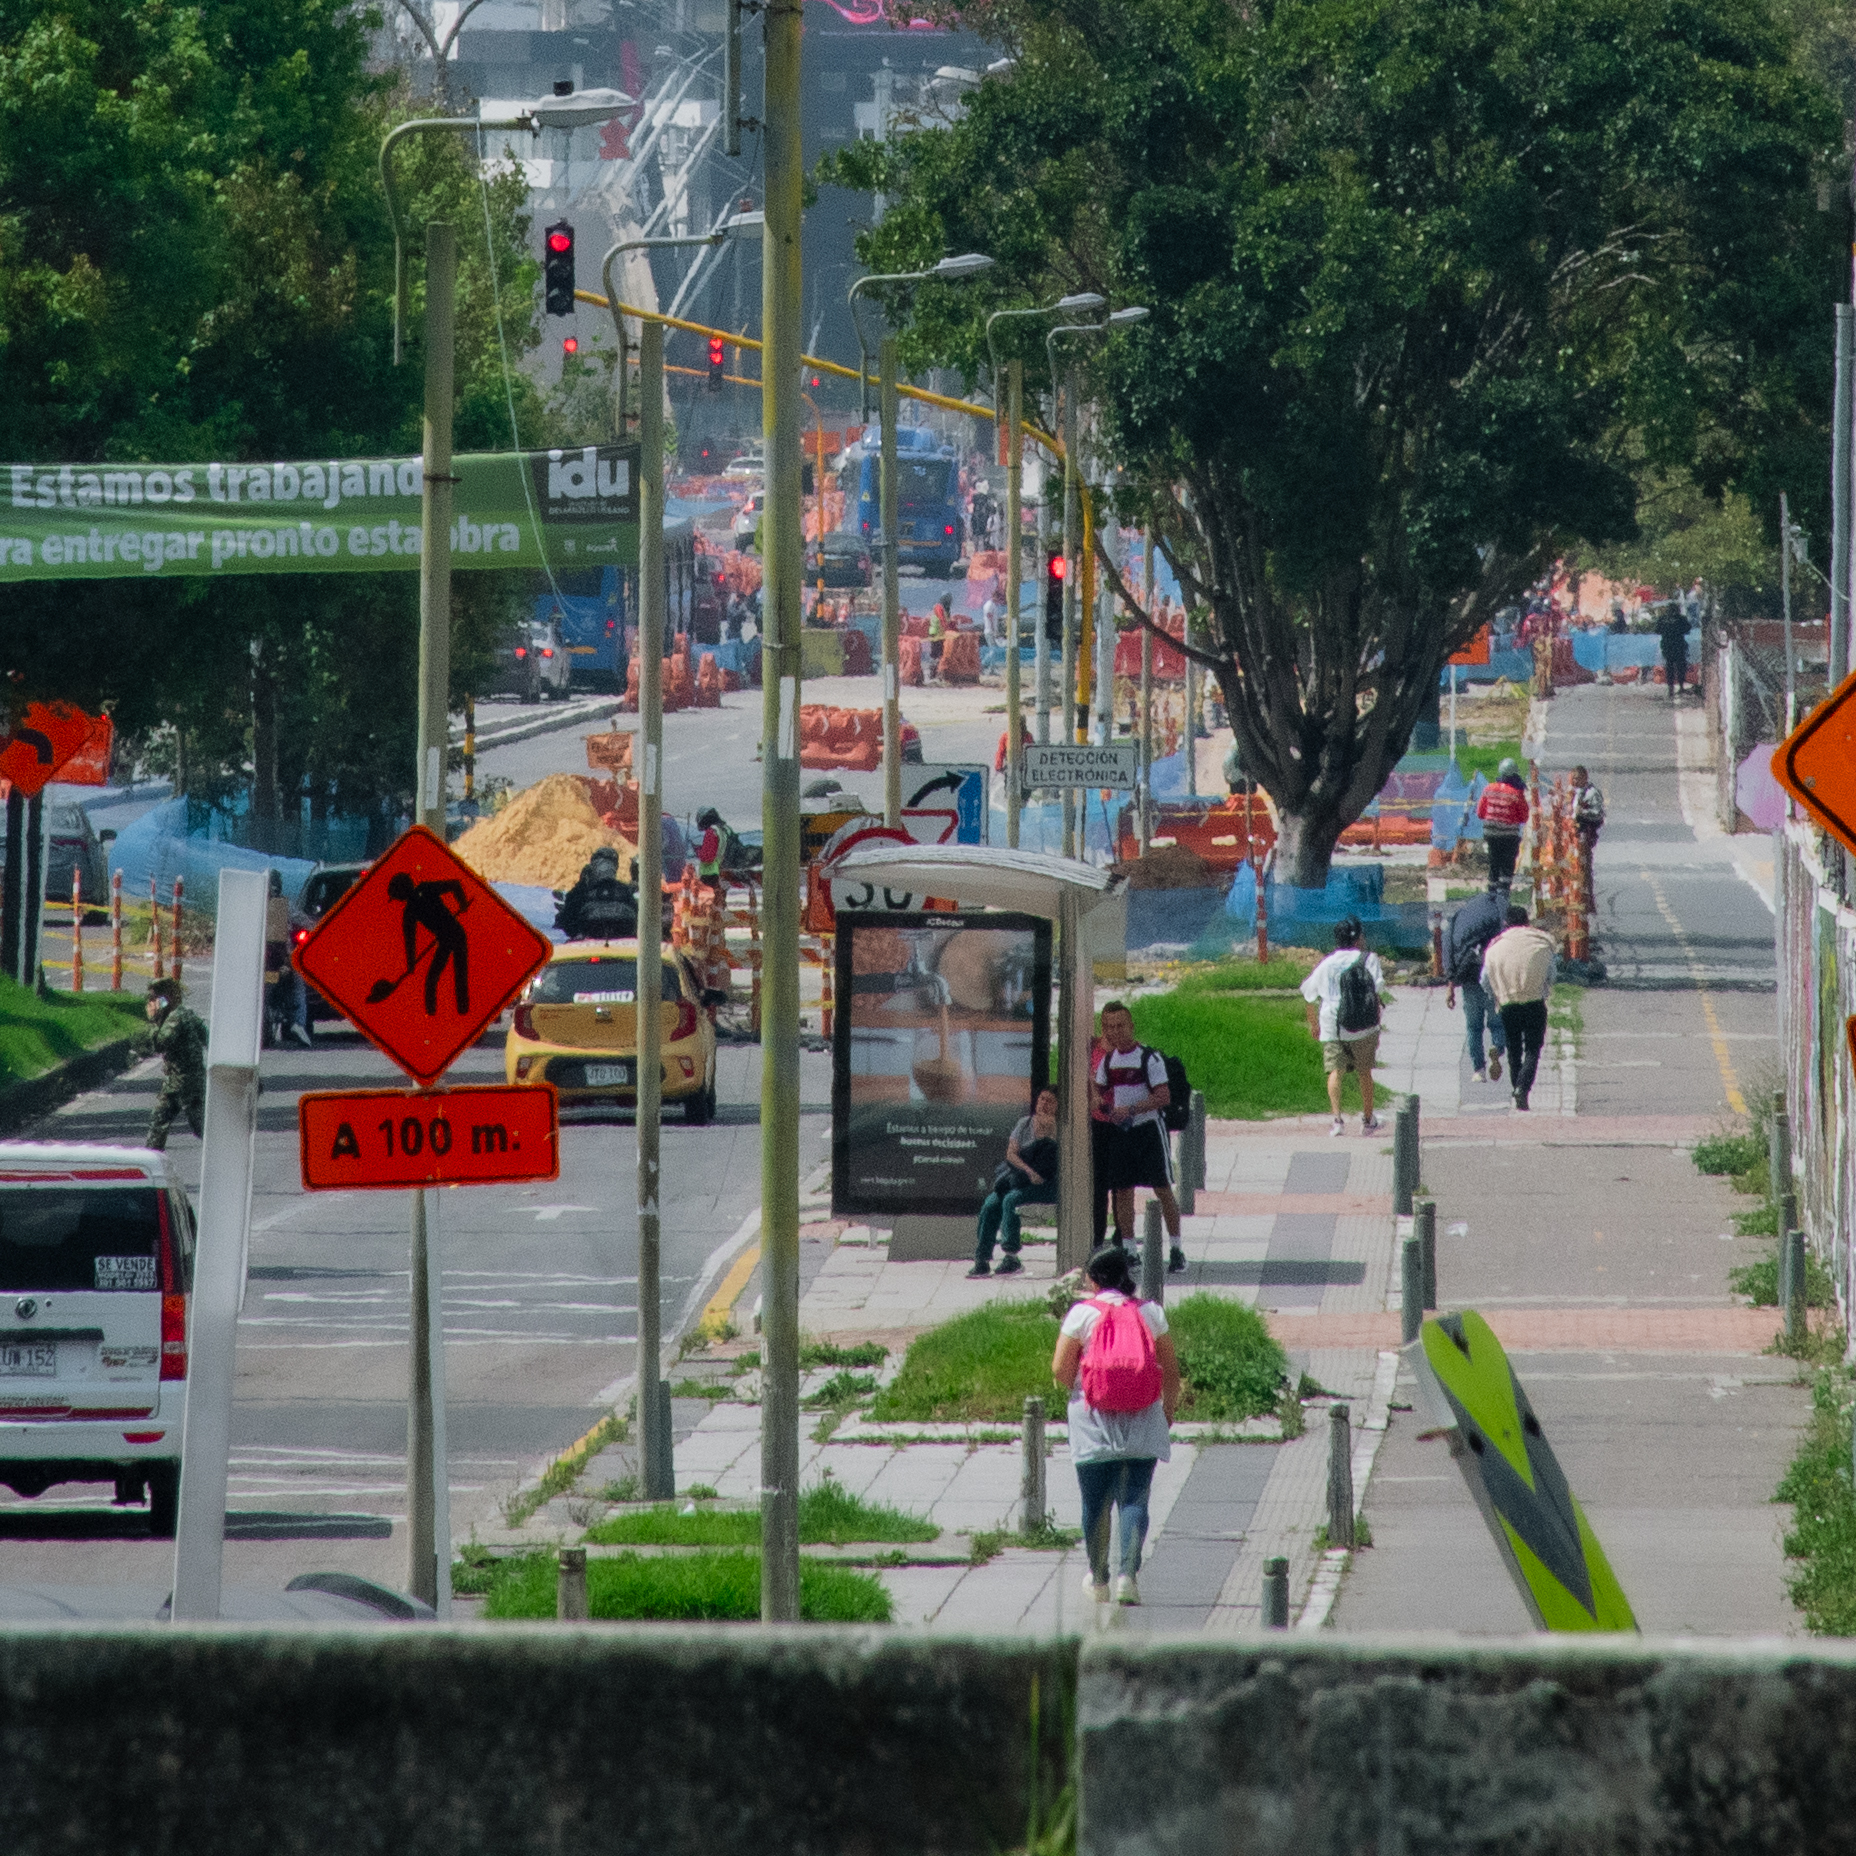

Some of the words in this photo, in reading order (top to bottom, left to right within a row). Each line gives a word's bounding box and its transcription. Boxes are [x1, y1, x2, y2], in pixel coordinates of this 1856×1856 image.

[10, 464, 196, 508] Estamos
[206, 456, 425, 510] trabajand
[547, 446, 630, 499] idu
[40, 528, 205, 572] entregar
[211, 521, 340, 569] pronto
[450, 515, 520, 553] bra
[1031, 768, 1128, 783] ELECTRÓNICA
[1039, 750, 1119, 766] DETECCIÓN
[331, 1122, 361, 1159] A
[378, 1117, 453, 1157] 100
[97, 1258, 112, 1271] SE
[115, 1258, 154, 1270] VENDE
